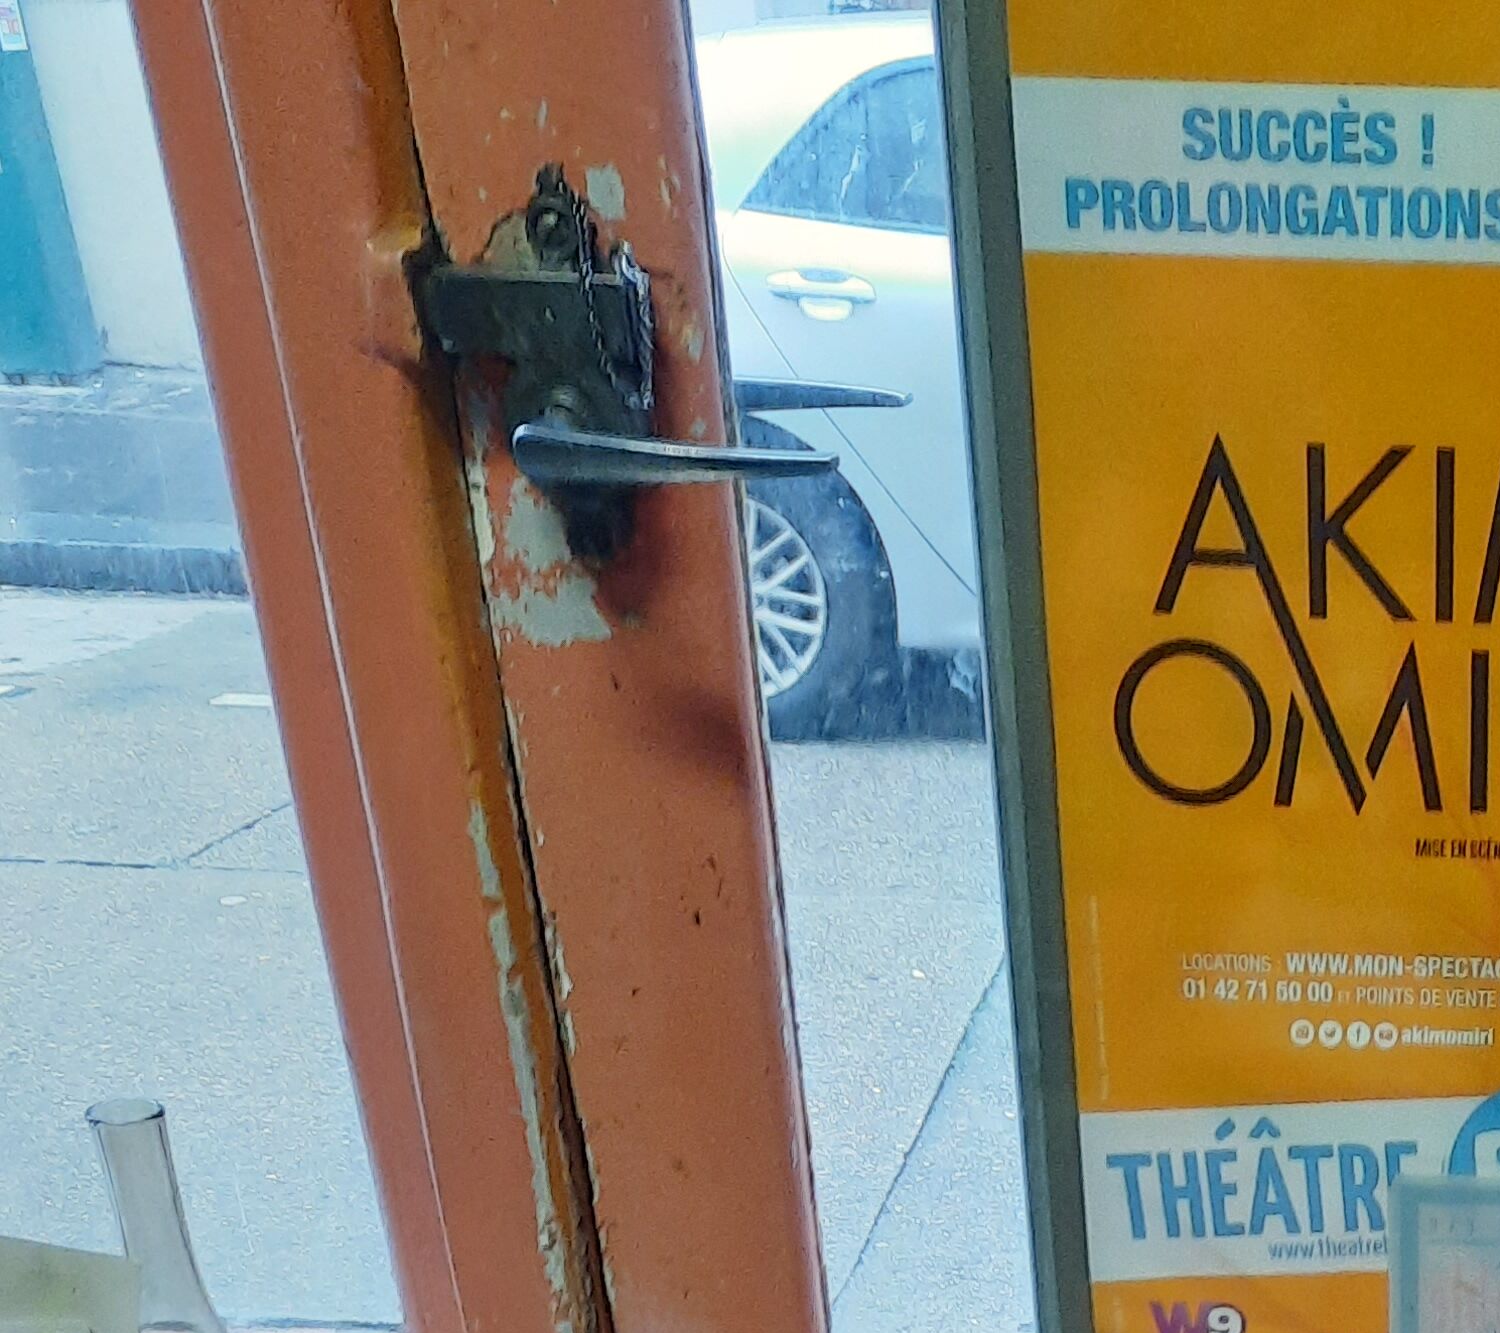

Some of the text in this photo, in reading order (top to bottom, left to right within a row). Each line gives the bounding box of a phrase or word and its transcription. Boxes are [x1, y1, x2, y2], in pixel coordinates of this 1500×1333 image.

[1182, 95, 1436, 166] SUCCÈS !
[1415, 838, 1447, 857] MISE
[1451, 840, 1467, 858] EN
[1182, 953, 1272, 973] LOCATIONS
[1183, 977, 1206, 998] 01
[1214, 977, 1239, 1000] 42
[1246, 979, 1268, 1001] 71
[1307, 981, 1333, 1003] 00
[1356, 986, 1414, 1006] POINTS
[1420, 988, 1442, 1008] DE
[1446, 988, 1496, 1009] VENTE
